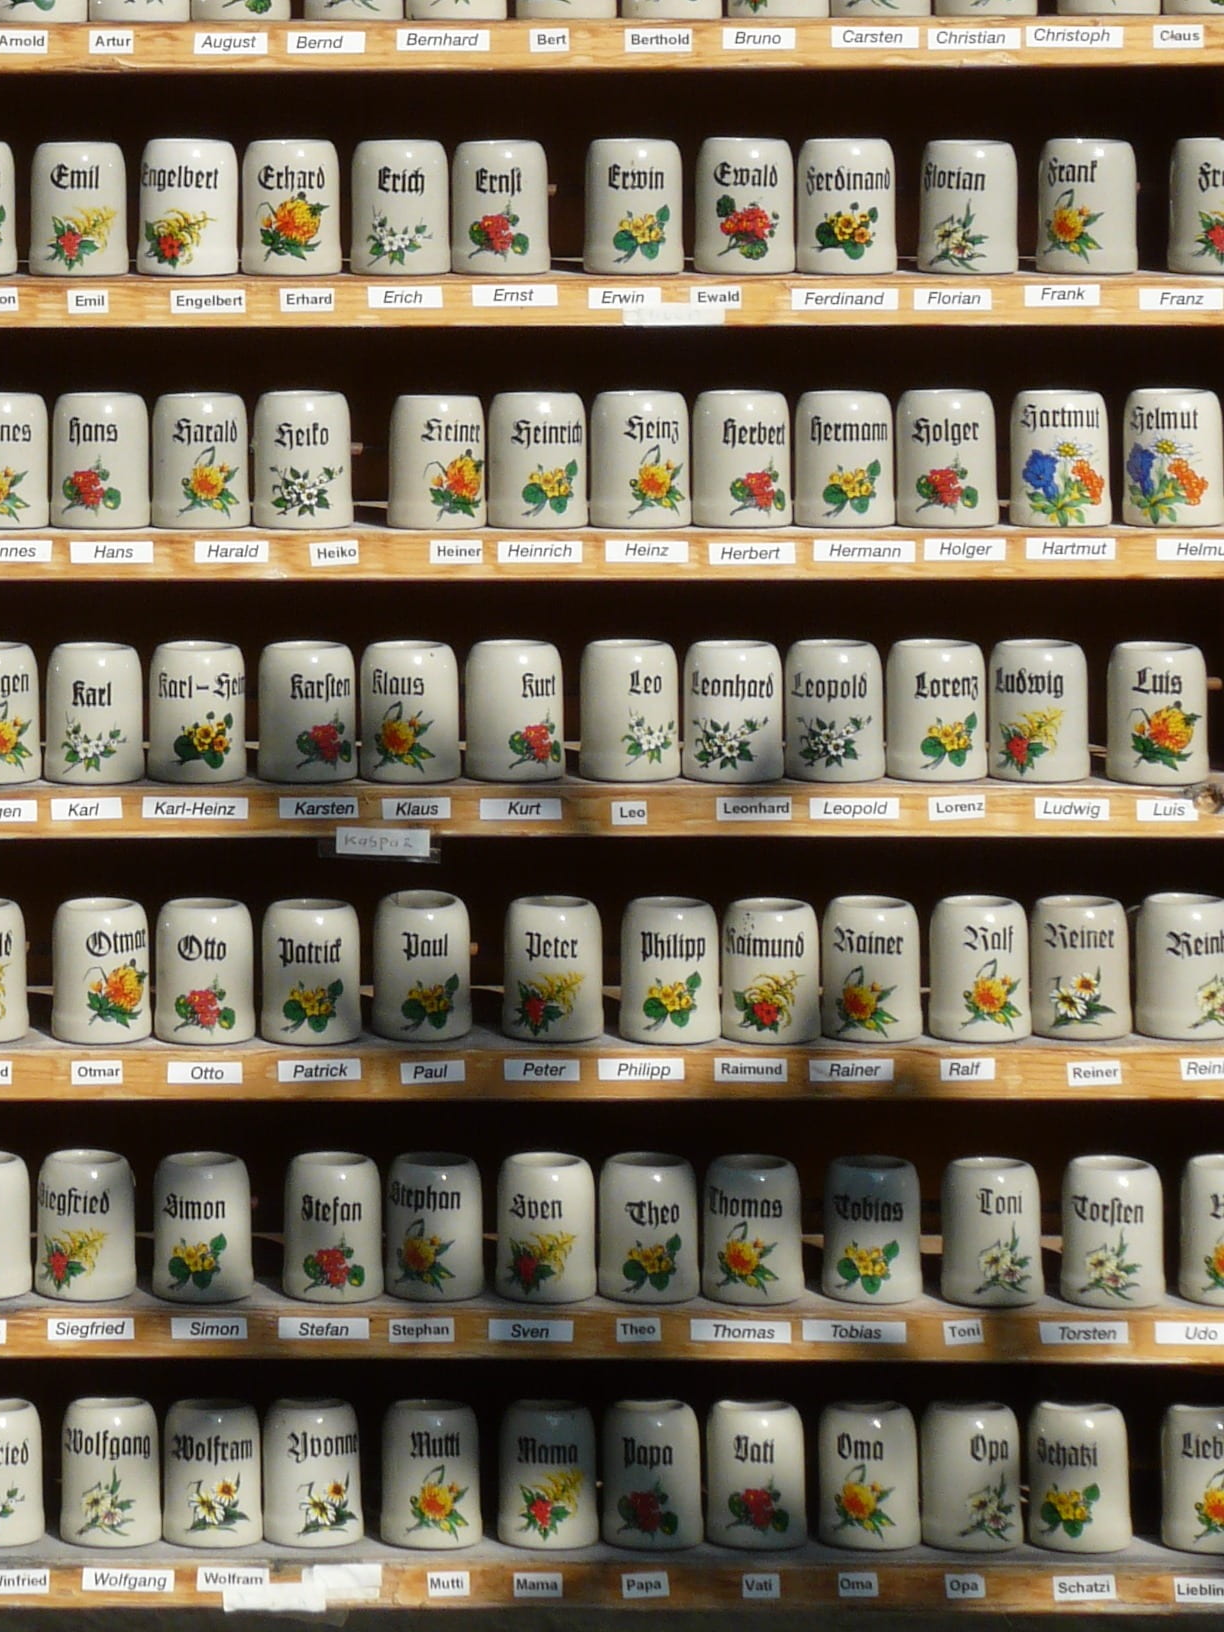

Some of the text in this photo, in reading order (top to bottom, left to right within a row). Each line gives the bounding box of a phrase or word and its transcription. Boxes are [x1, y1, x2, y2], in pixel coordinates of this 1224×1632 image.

[201, 35, 256, 52] August
[406, 32, 479, 46] Bernhard
[631, 33, 690, 46] Berthold
[735, 32, 781, 45] Bruno
[937, 30, 1006, 45] Christian
[49, 164, 100, 190] Emil
[176, 295, 243, 310] Engelbert
[804, 291, 885, 305] Ferdinand
[927, 291, 981, 305] Florian
[94, 545, 133, 559] Hans
[507, 544, 572, 558] Heinrich
[720, 546, 780, 560] Herbert
[1042, 541, 1107, 555] Hartmut
[627, 670, 662, 696] Leo
[71, 679, 112, 707] Karl
[154, 801, 236, 816] Karl-Heinz
[395, 801, 439, 817] Klaus
[823, 801, 888, 818] Leopold
[1043, 801, 1101, 819] Ludwig
[177, 934, 226, 961] Otto
[525, 931, 579, 962] Peter
[292, 1062, 349, 1079] Patrick
[617, 1062, 671, 1081] Philipp
[948, 1062, 981, 1077] Ralf
[190, 1321, 240, 1337] Simon
[299, 1322, 349, 1336] Stefan
[712, 1323, 775, 1339] Thomas
[831, 1326, 881, 1339] Tobias
[836, 1431, 884, 1463] Oma
[94, 1573, 167, 1589] Wolfgang
[430, 1577, 464, 1589] Mutti
[626, 1579, 662, 1593] Papa
[1058, 1580, 1110, 1593] Schatzi
